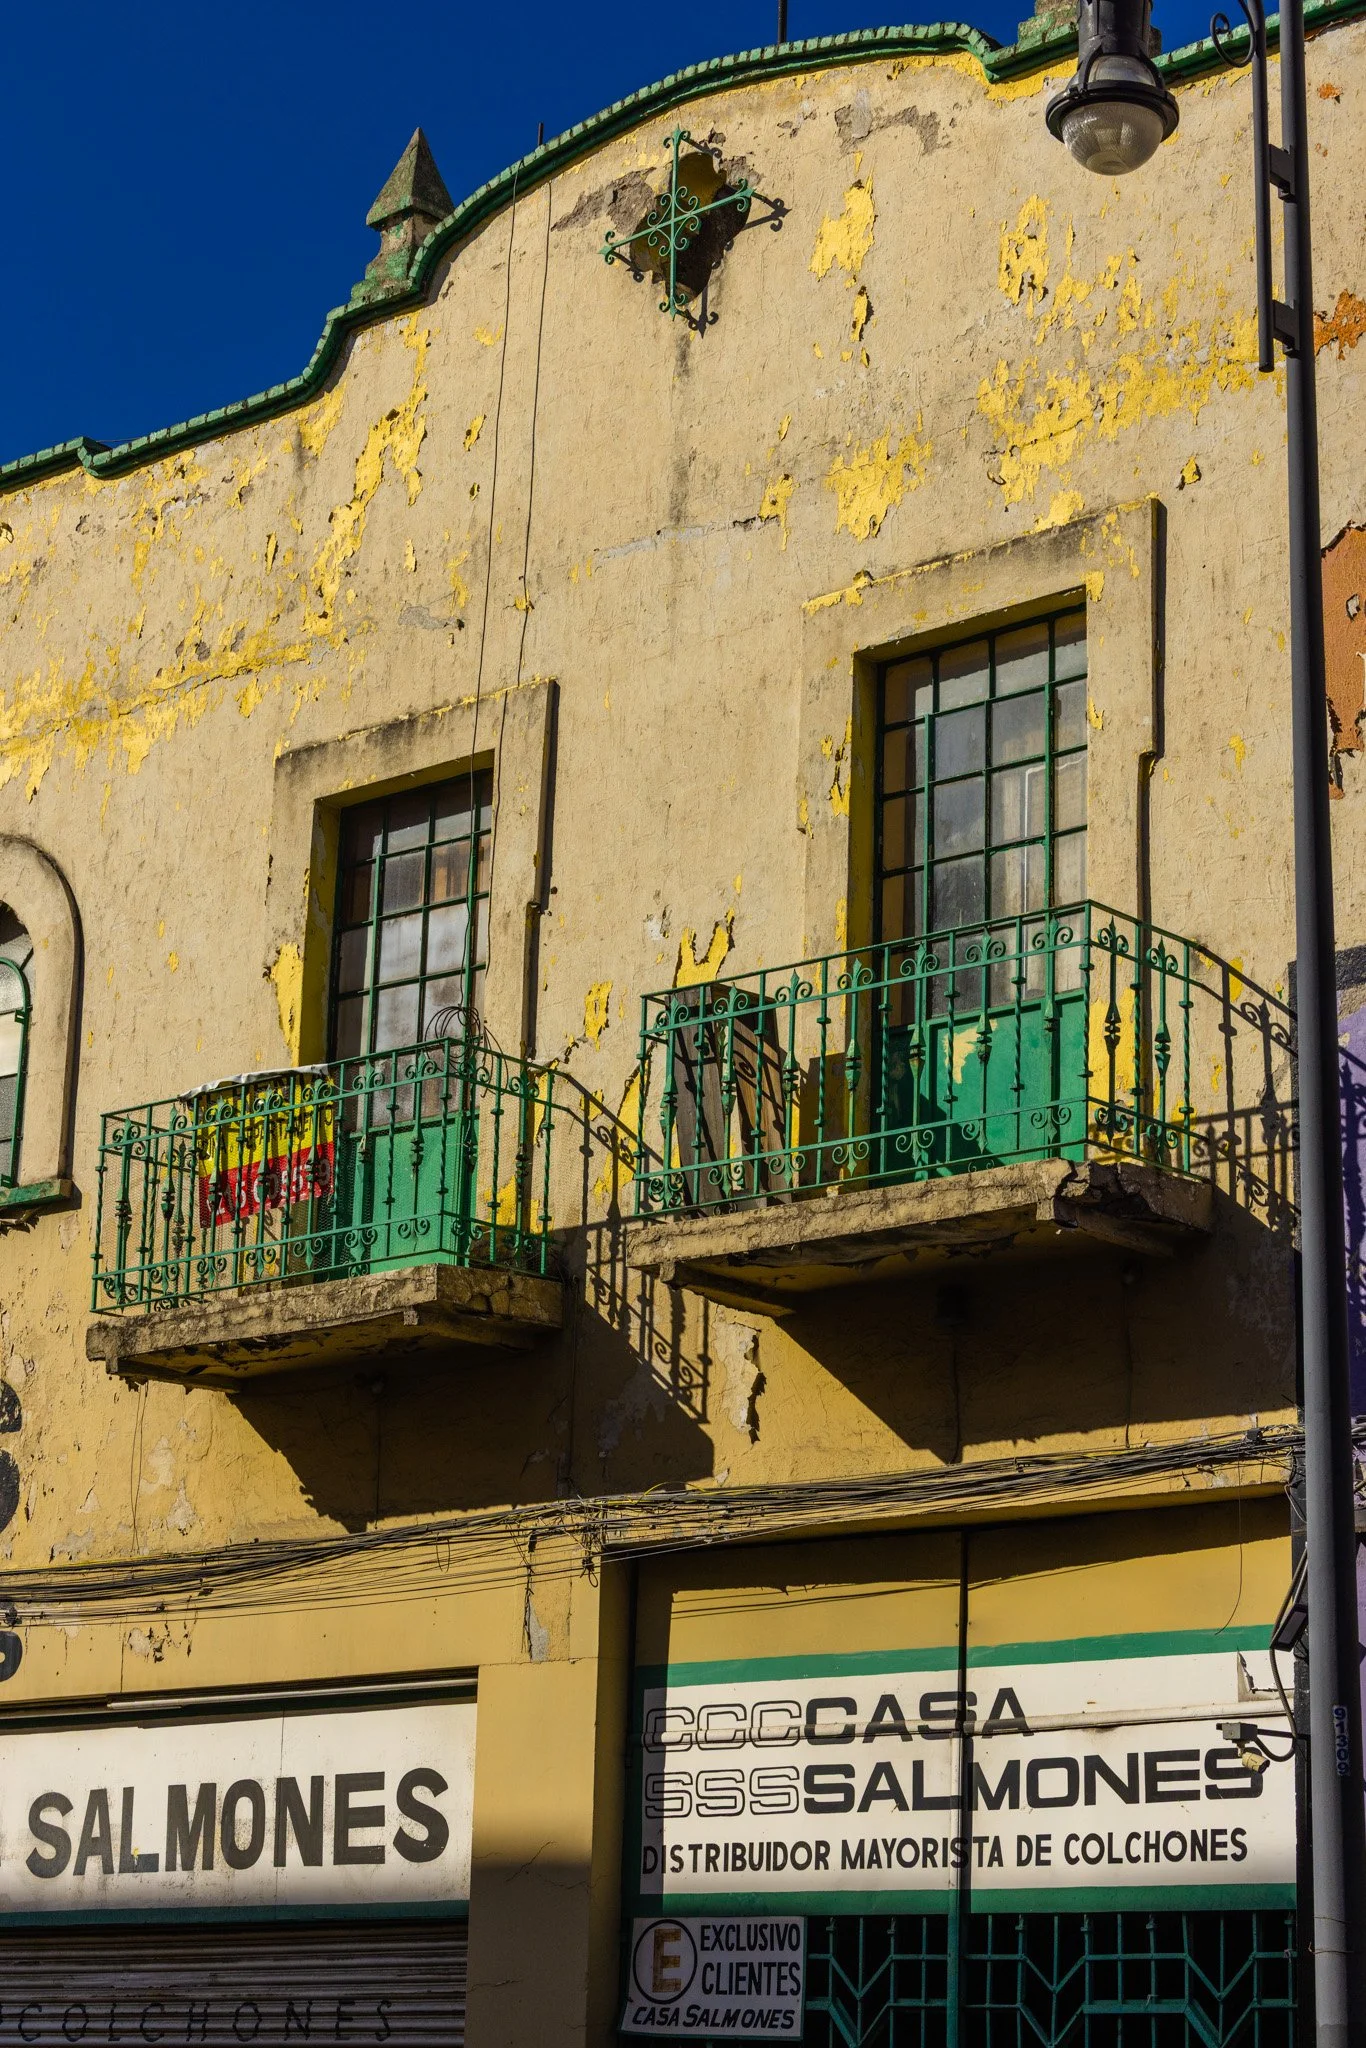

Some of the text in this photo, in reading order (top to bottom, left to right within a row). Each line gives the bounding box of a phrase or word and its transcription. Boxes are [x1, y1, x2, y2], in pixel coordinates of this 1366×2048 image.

[1333, 1706, 1350, 1776] 91309
[26, 1767, 450, 1879] SALMONES
[642, 1827, 1249, 1875] DISTRIBUIDOR MAYORISTA DE COLCHONES
[700, 1923, 801, 1952] EXCLUSIVO
[701, 1961, 802, 1997] CLIENTES
[17, 2000, 392, 2043] COLCHONES
[631, 2004, 796, 2030] CASA SALMONES
